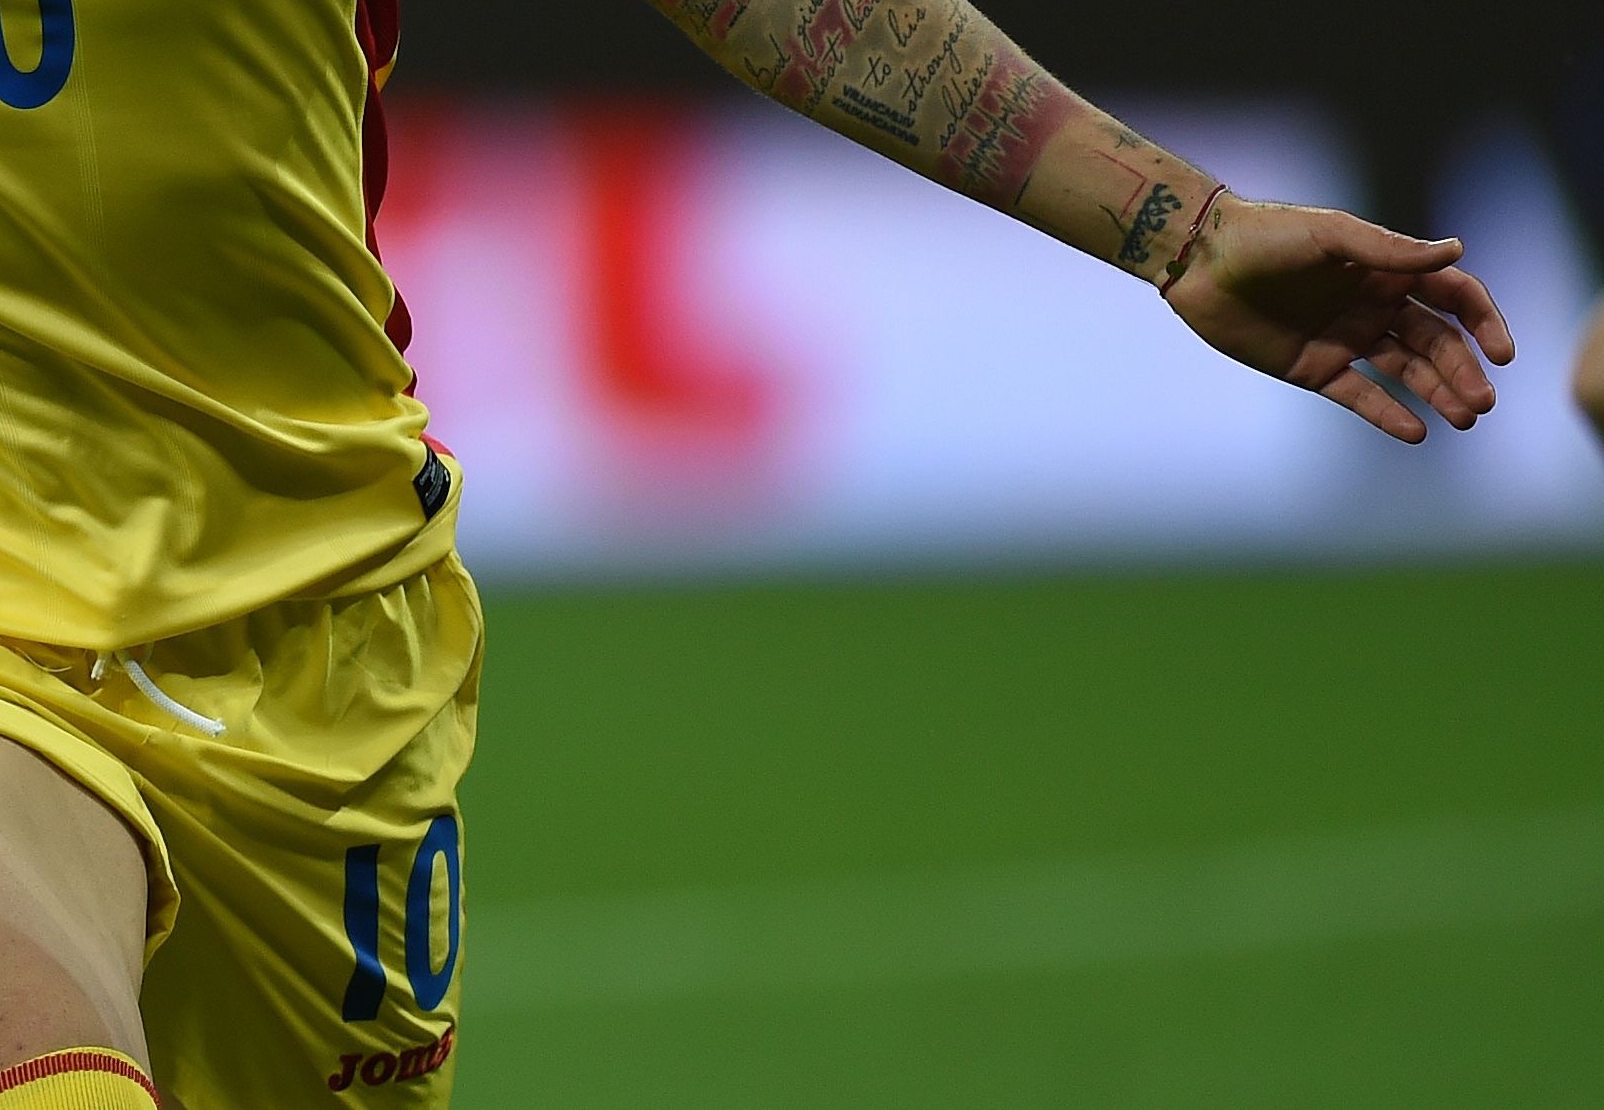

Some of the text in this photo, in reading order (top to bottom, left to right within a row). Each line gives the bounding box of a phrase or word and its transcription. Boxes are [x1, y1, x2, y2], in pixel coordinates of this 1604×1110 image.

[862, 54, 893, 89] to
[888, 7, 927, 48] his
[939, 52, 994, 150] soldiers
[342, 814, 460, 1023] 10
